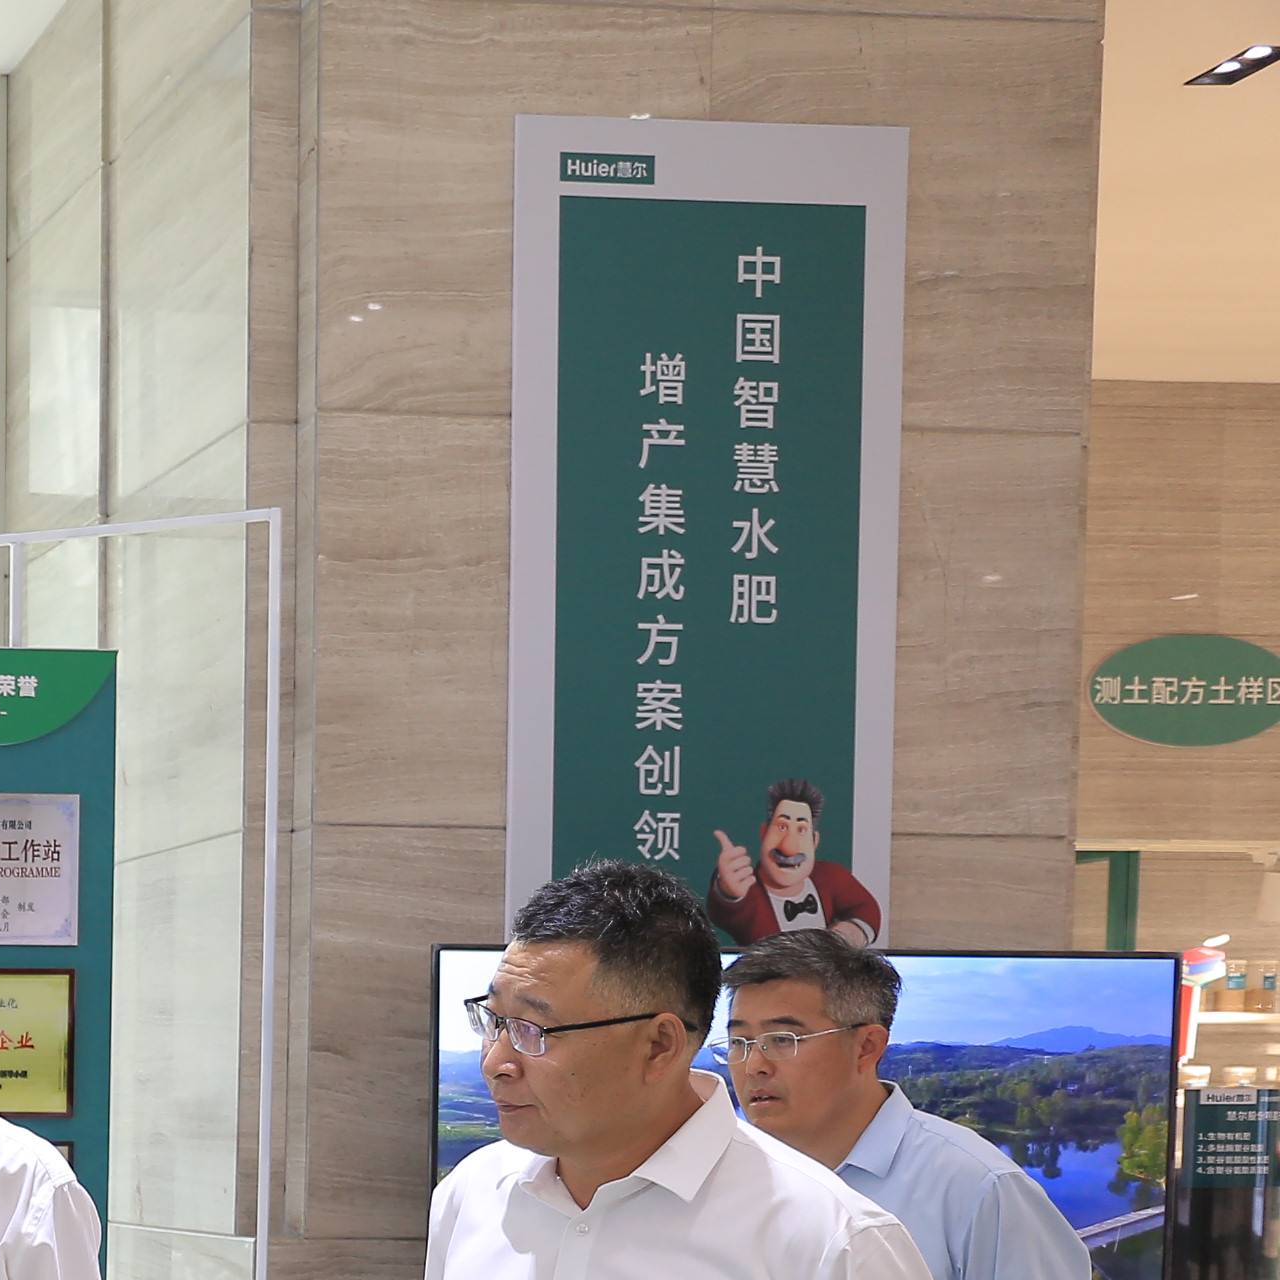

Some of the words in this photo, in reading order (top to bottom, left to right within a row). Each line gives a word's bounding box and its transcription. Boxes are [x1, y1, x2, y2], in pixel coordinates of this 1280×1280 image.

[567, 158, 647, 178] Huier慧尔
[633, 352, 687, 862] 增产集成方案创领
[729, 245, 783, 626] 中国智慧水肥
